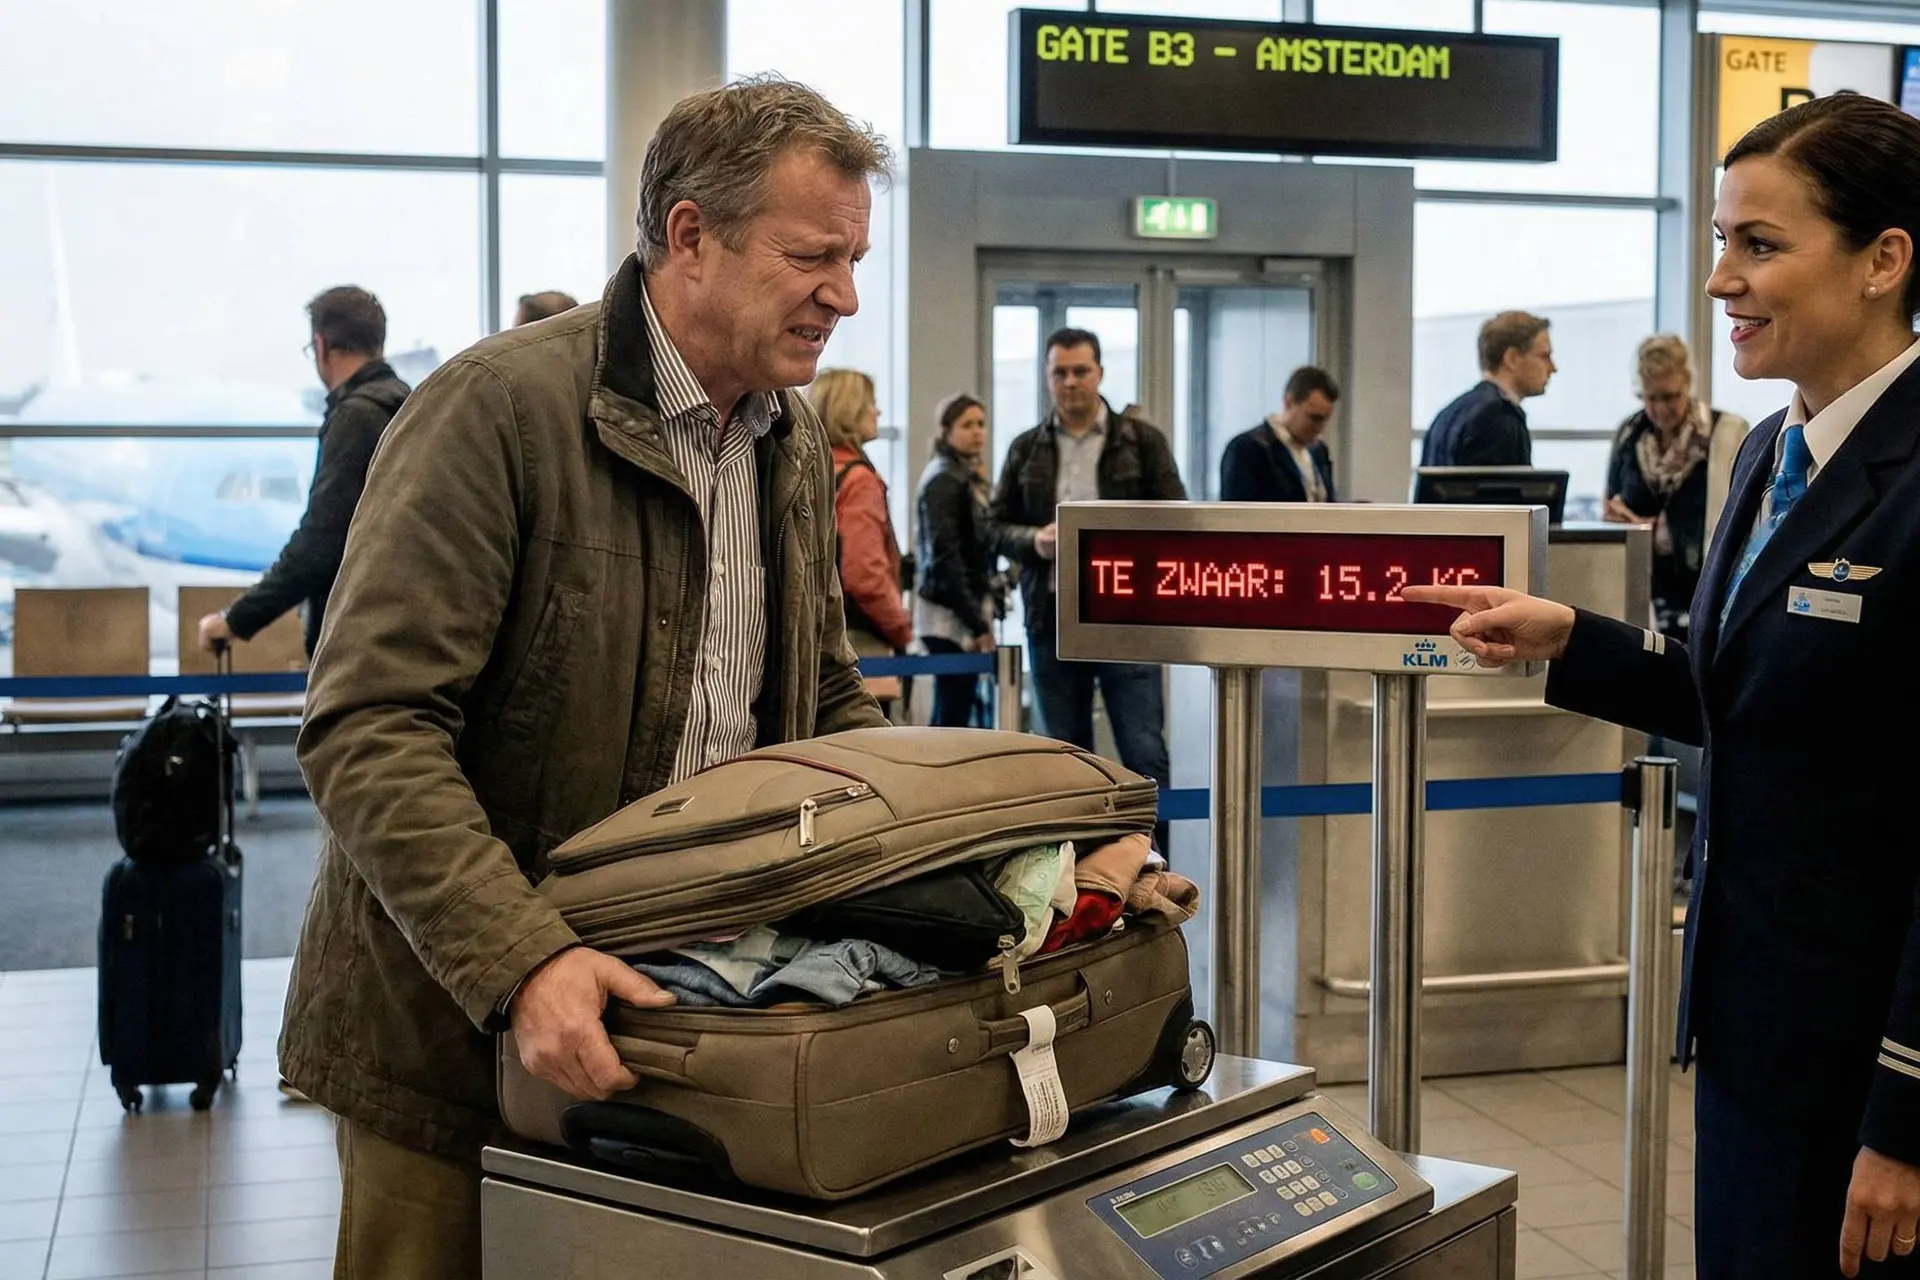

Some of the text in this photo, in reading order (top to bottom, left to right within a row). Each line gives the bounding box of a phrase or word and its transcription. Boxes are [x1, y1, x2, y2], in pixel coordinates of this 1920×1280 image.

[1036, 25, 1450, 79] GATE B3 - AMSTERDAM
[1725, 49, 1787, 73] GATE
[1091, 560, 1134, 595] TE
[1156, 561, 1284, 598] ZWAAR:
[1319, 565, 1406, 602] 15.2
[1403, 653, 1448, 668] KLM
